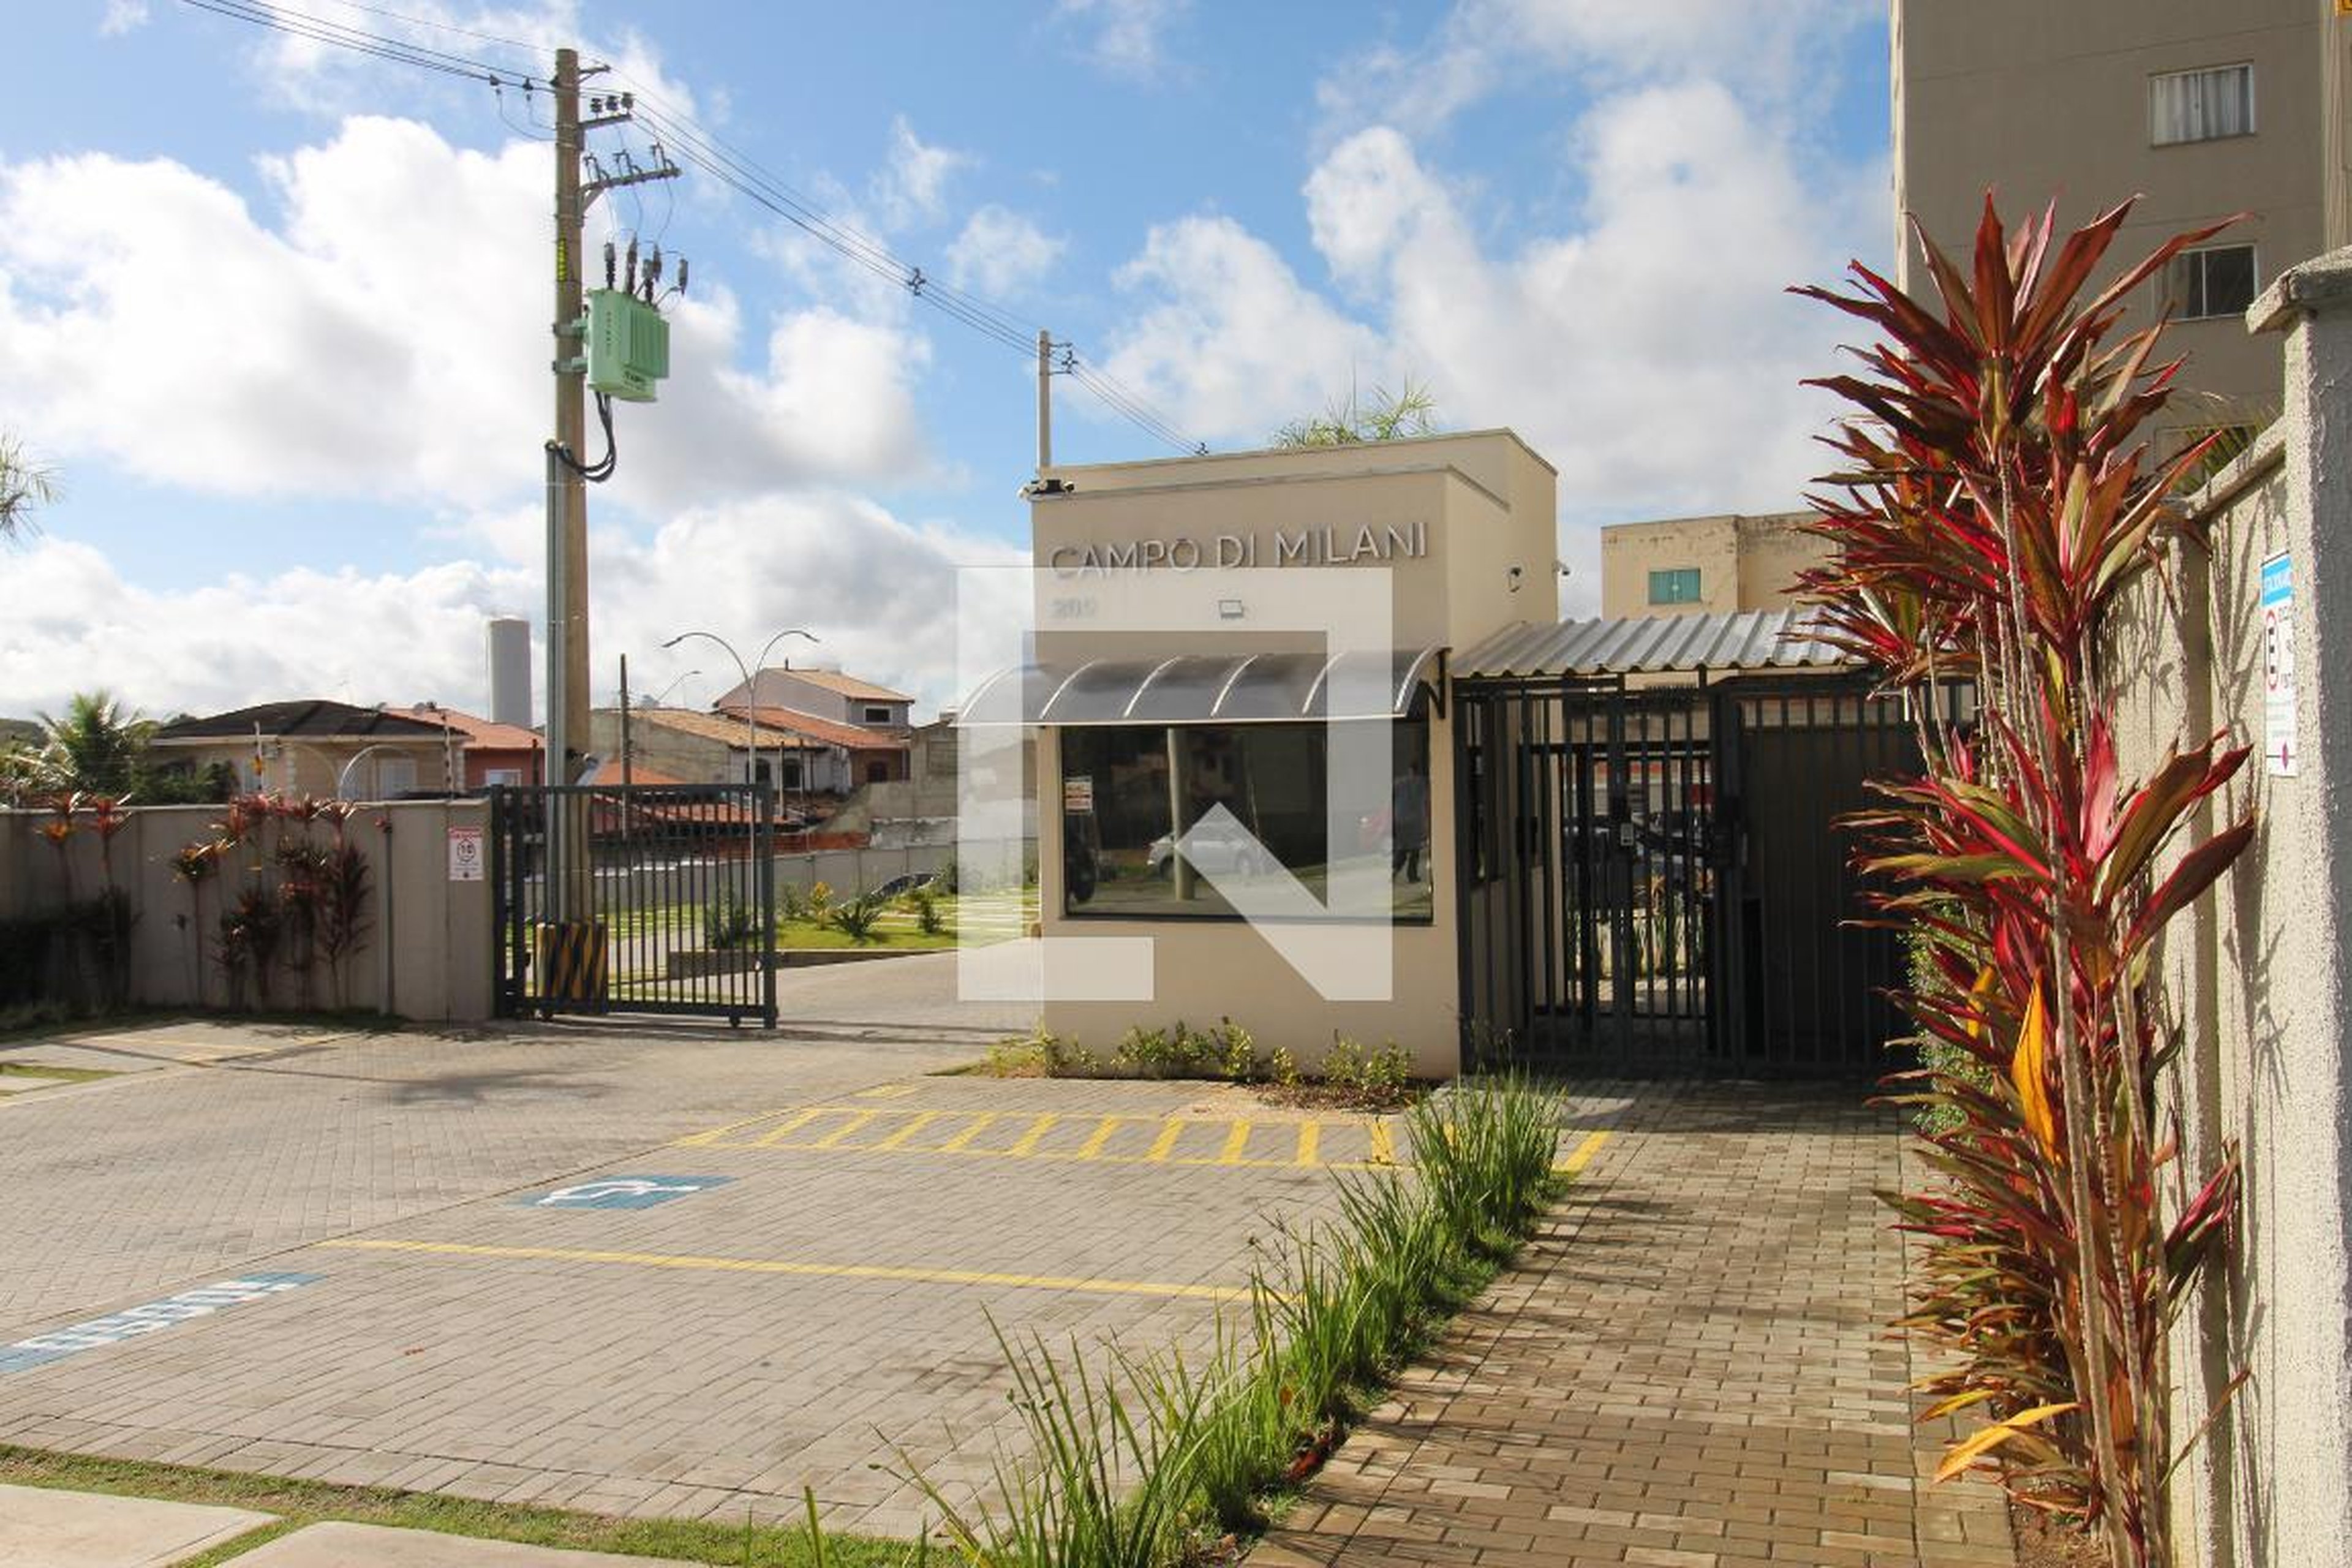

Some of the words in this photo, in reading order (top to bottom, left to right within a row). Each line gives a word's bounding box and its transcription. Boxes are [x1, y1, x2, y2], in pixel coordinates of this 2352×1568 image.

[1050, 538, 1200, 578] CAMPO
[1216, 534, 1256, 568] DI
[1275, 522, 1427, 567] MILANI
